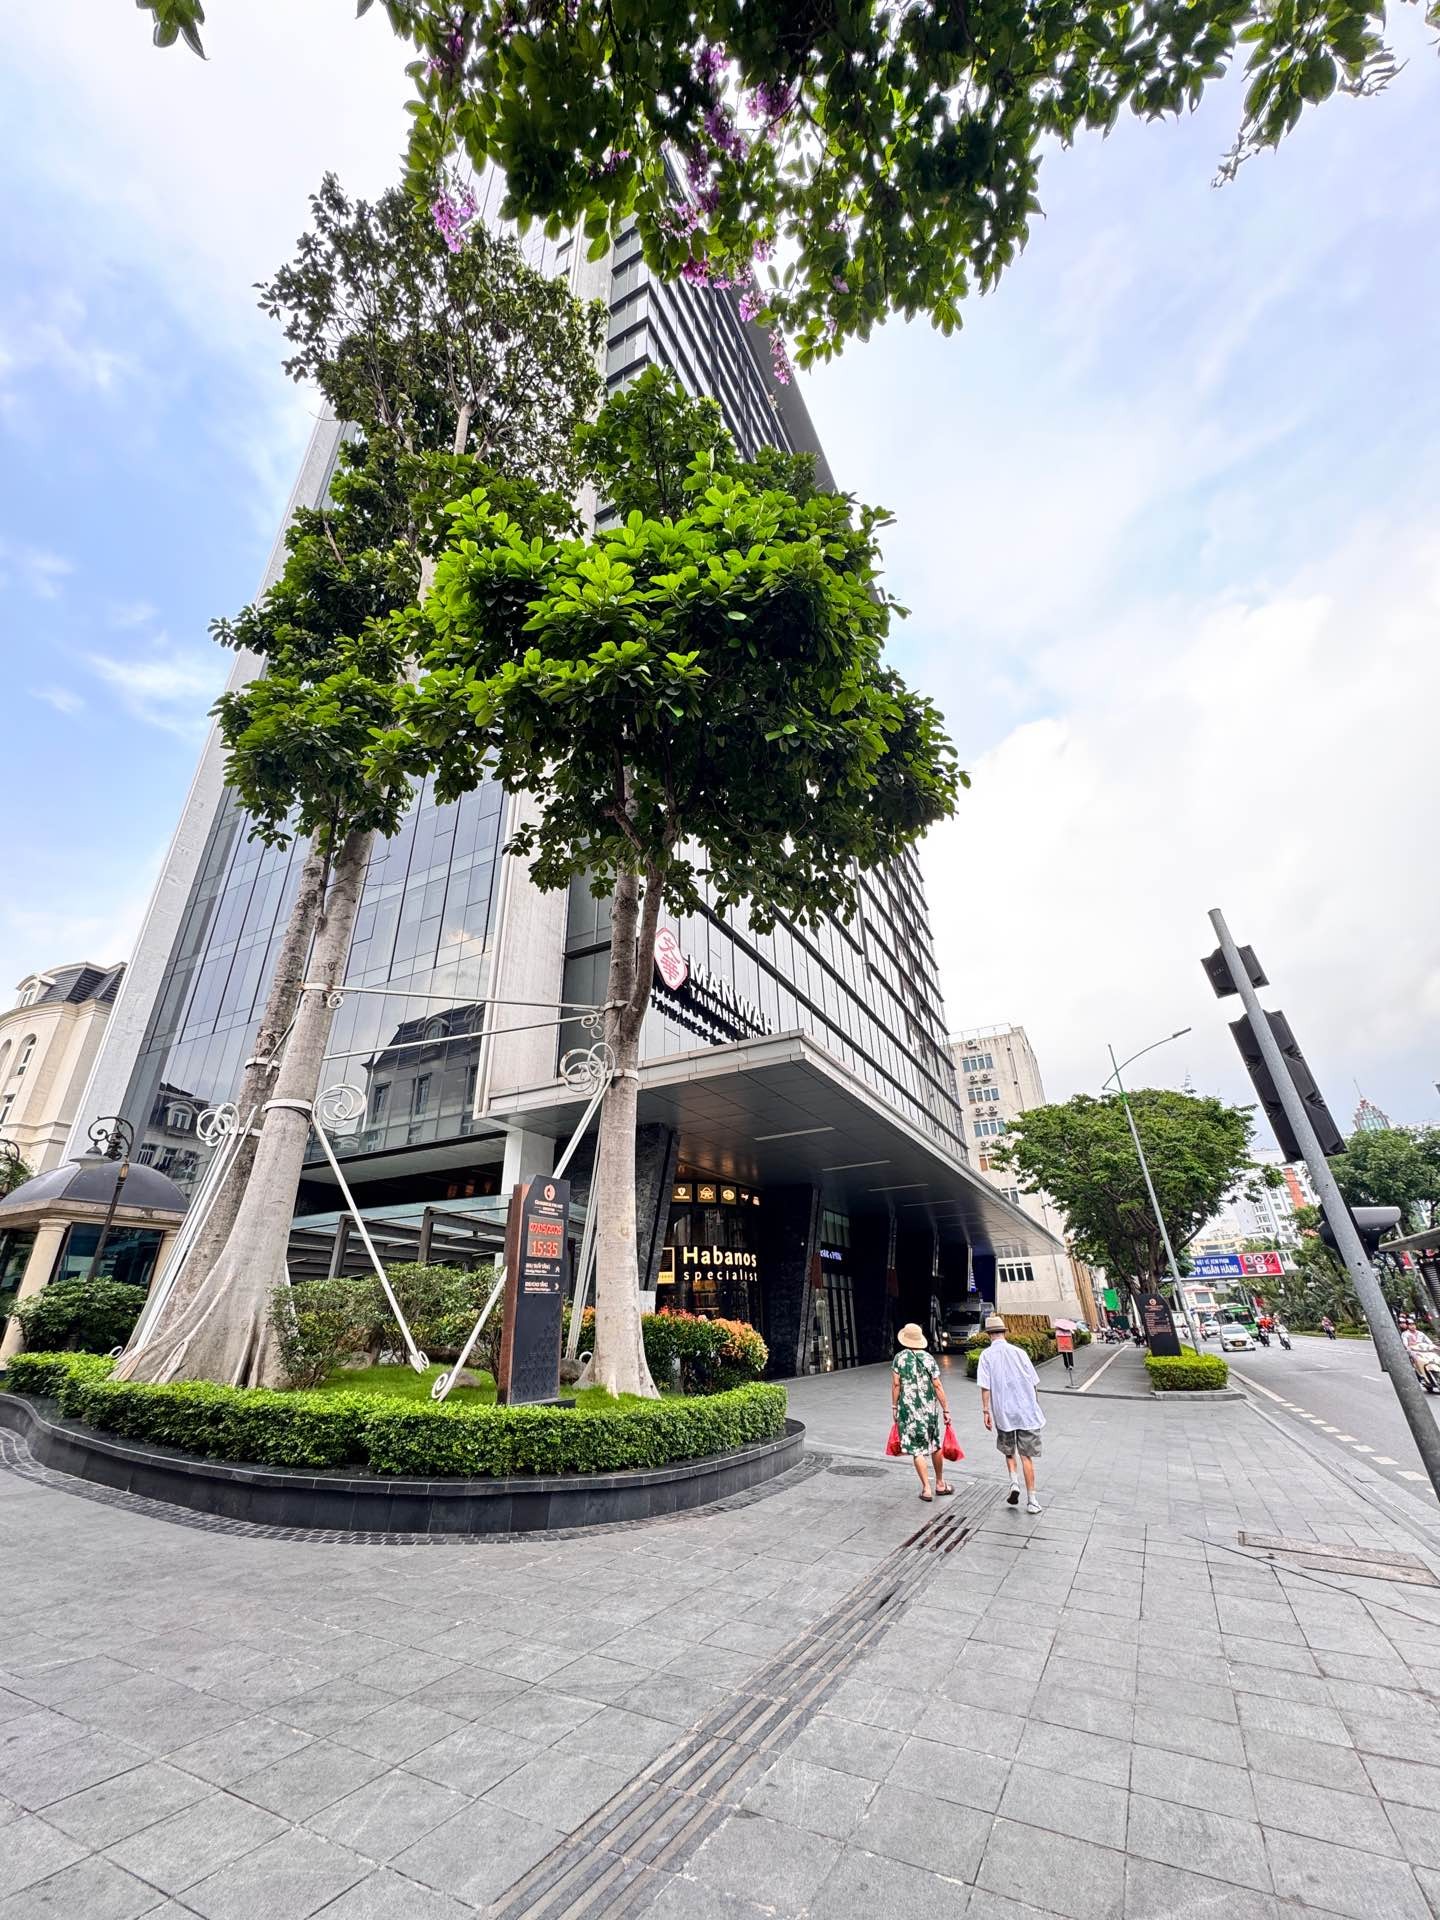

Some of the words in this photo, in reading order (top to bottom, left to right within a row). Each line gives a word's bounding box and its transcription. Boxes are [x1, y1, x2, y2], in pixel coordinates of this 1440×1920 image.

[690, 954, 775, 1035] MANWAH
[690, 984, 745, 1034] TAIWANESE
[746, 1027, 762, 1039] HO
[531, 1240, 559, 1257] 15:35
[683, 1245, 757, 1268] Habanos
[683, 1268, 758, 1283] specialist
